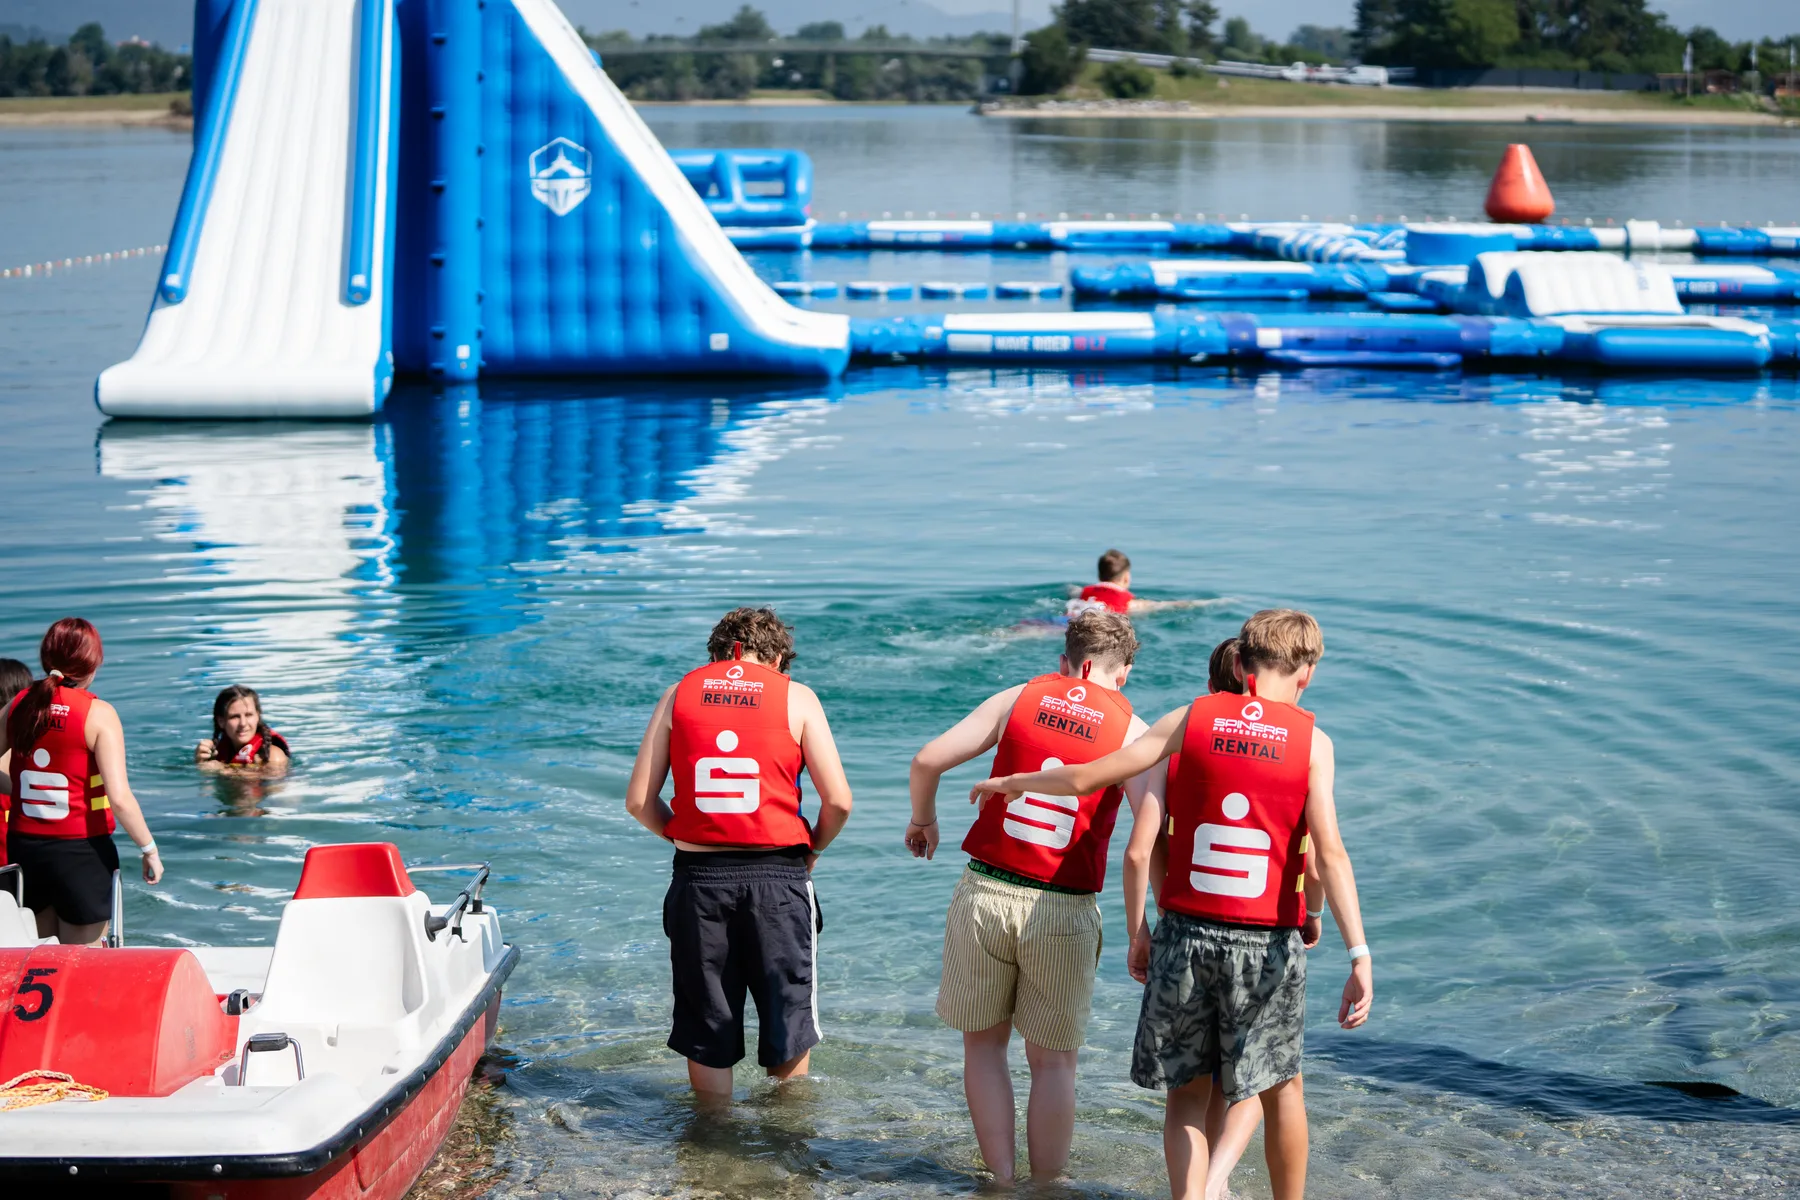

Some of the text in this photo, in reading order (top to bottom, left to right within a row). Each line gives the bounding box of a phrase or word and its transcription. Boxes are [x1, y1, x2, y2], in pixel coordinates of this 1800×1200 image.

[702, 685, 763, 693] PROFESSIONAL
[703, 678, 764, 689] SPINERA
[703, 693, 757, 707] RENTAL
[1041, 695, 1105, 720] SPINERA
[1039, 702, 1102, 725] PROFESSIONAL
[1037, 711, 1093, 739] RENTAL
[1212, 726, 1287, 742] PROFESSIONAL
[1213, 717, 1288, 737] SPINERA
[1213, 738, 1280, 760] RENTAL
[13, 968, 58, 1022] 5
